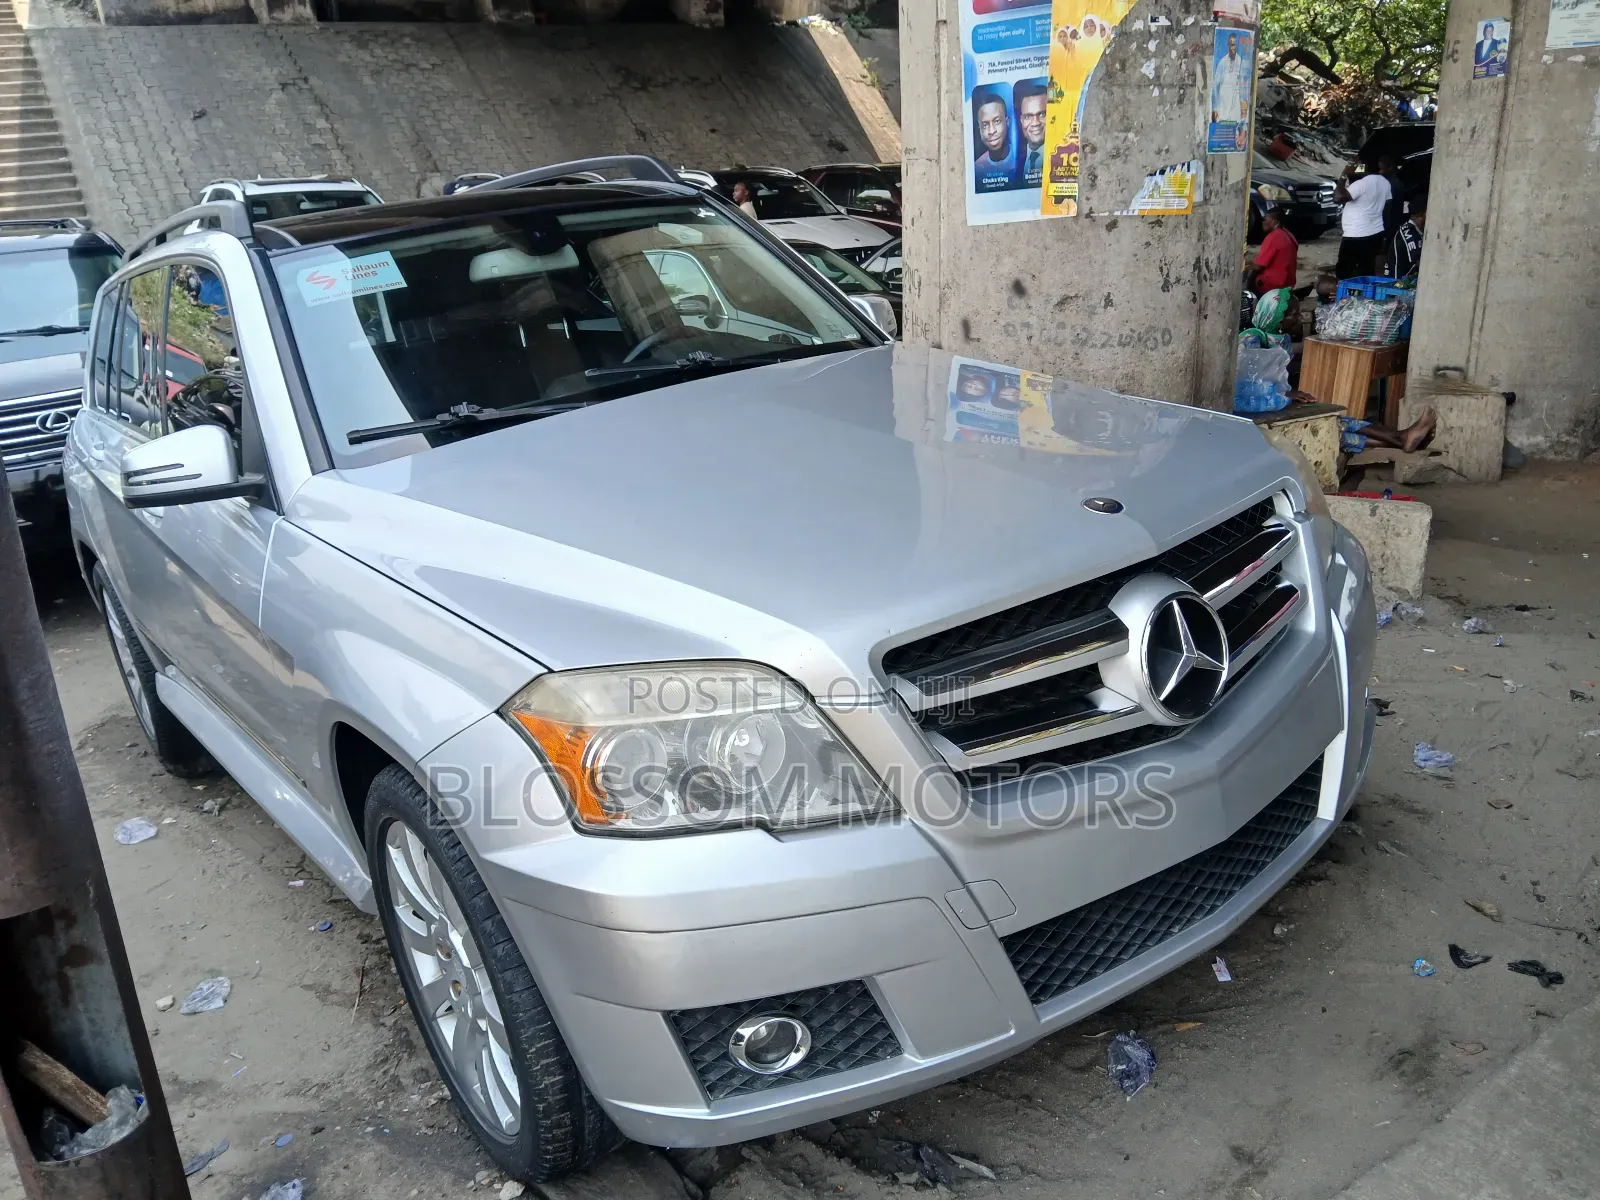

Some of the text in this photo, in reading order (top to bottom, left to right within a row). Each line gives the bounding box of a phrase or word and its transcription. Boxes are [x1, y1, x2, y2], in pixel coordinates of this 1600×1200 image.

[1060, 152, 1078, 166] 10
[341, 260, 390, 275] Sallaum
[345, 270, 378, 281] Lines
[310, 280, 403, 304] www.sallaumlines.com
